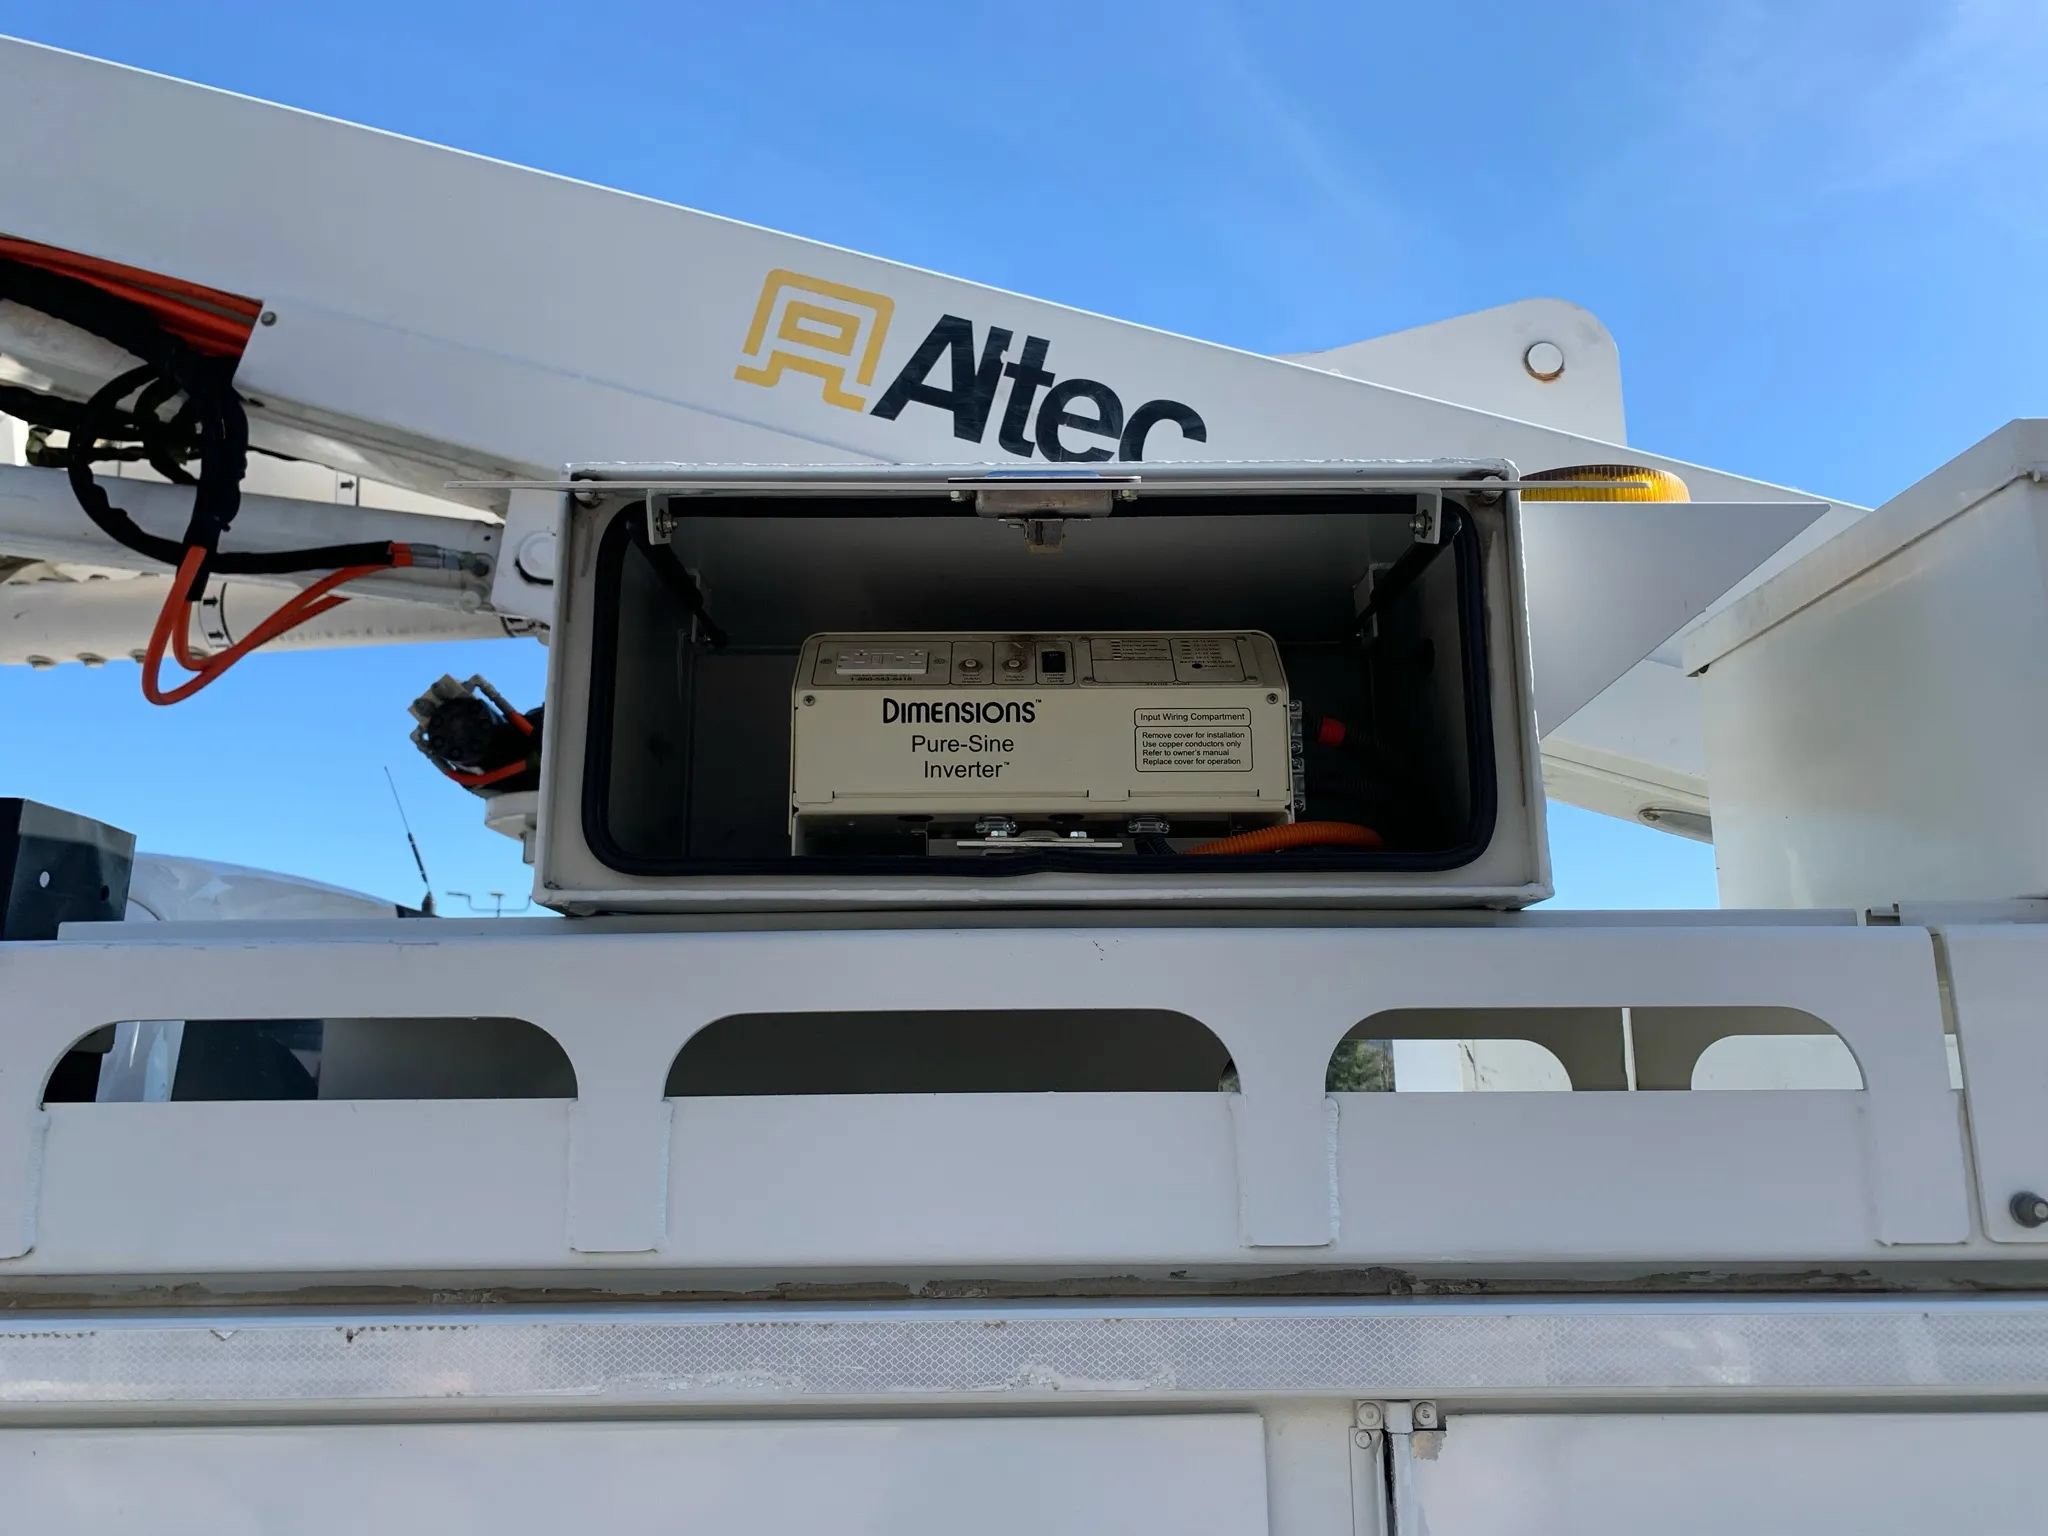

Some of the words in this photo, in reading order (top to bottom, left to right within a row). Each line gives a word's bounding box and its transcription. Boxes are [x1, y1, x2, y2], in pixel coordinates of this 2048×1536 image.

[869, 313, 1207, 462] Altec
[1140, 713, 1161, 722] Input
[1162, 713, 1189, 722] Wiring
[1190, 712, 1245, 722] Compartment
[1142, 731, 1172, 739] Remove
[912, 734, 1014, 752] Pure-Sine
[1142, 740, 1157, 748] Use
[1226, 740, 1241, 748] only
[1142, 758, 1173, 766] Replace
[1206, 758, 1241, 766] operation
